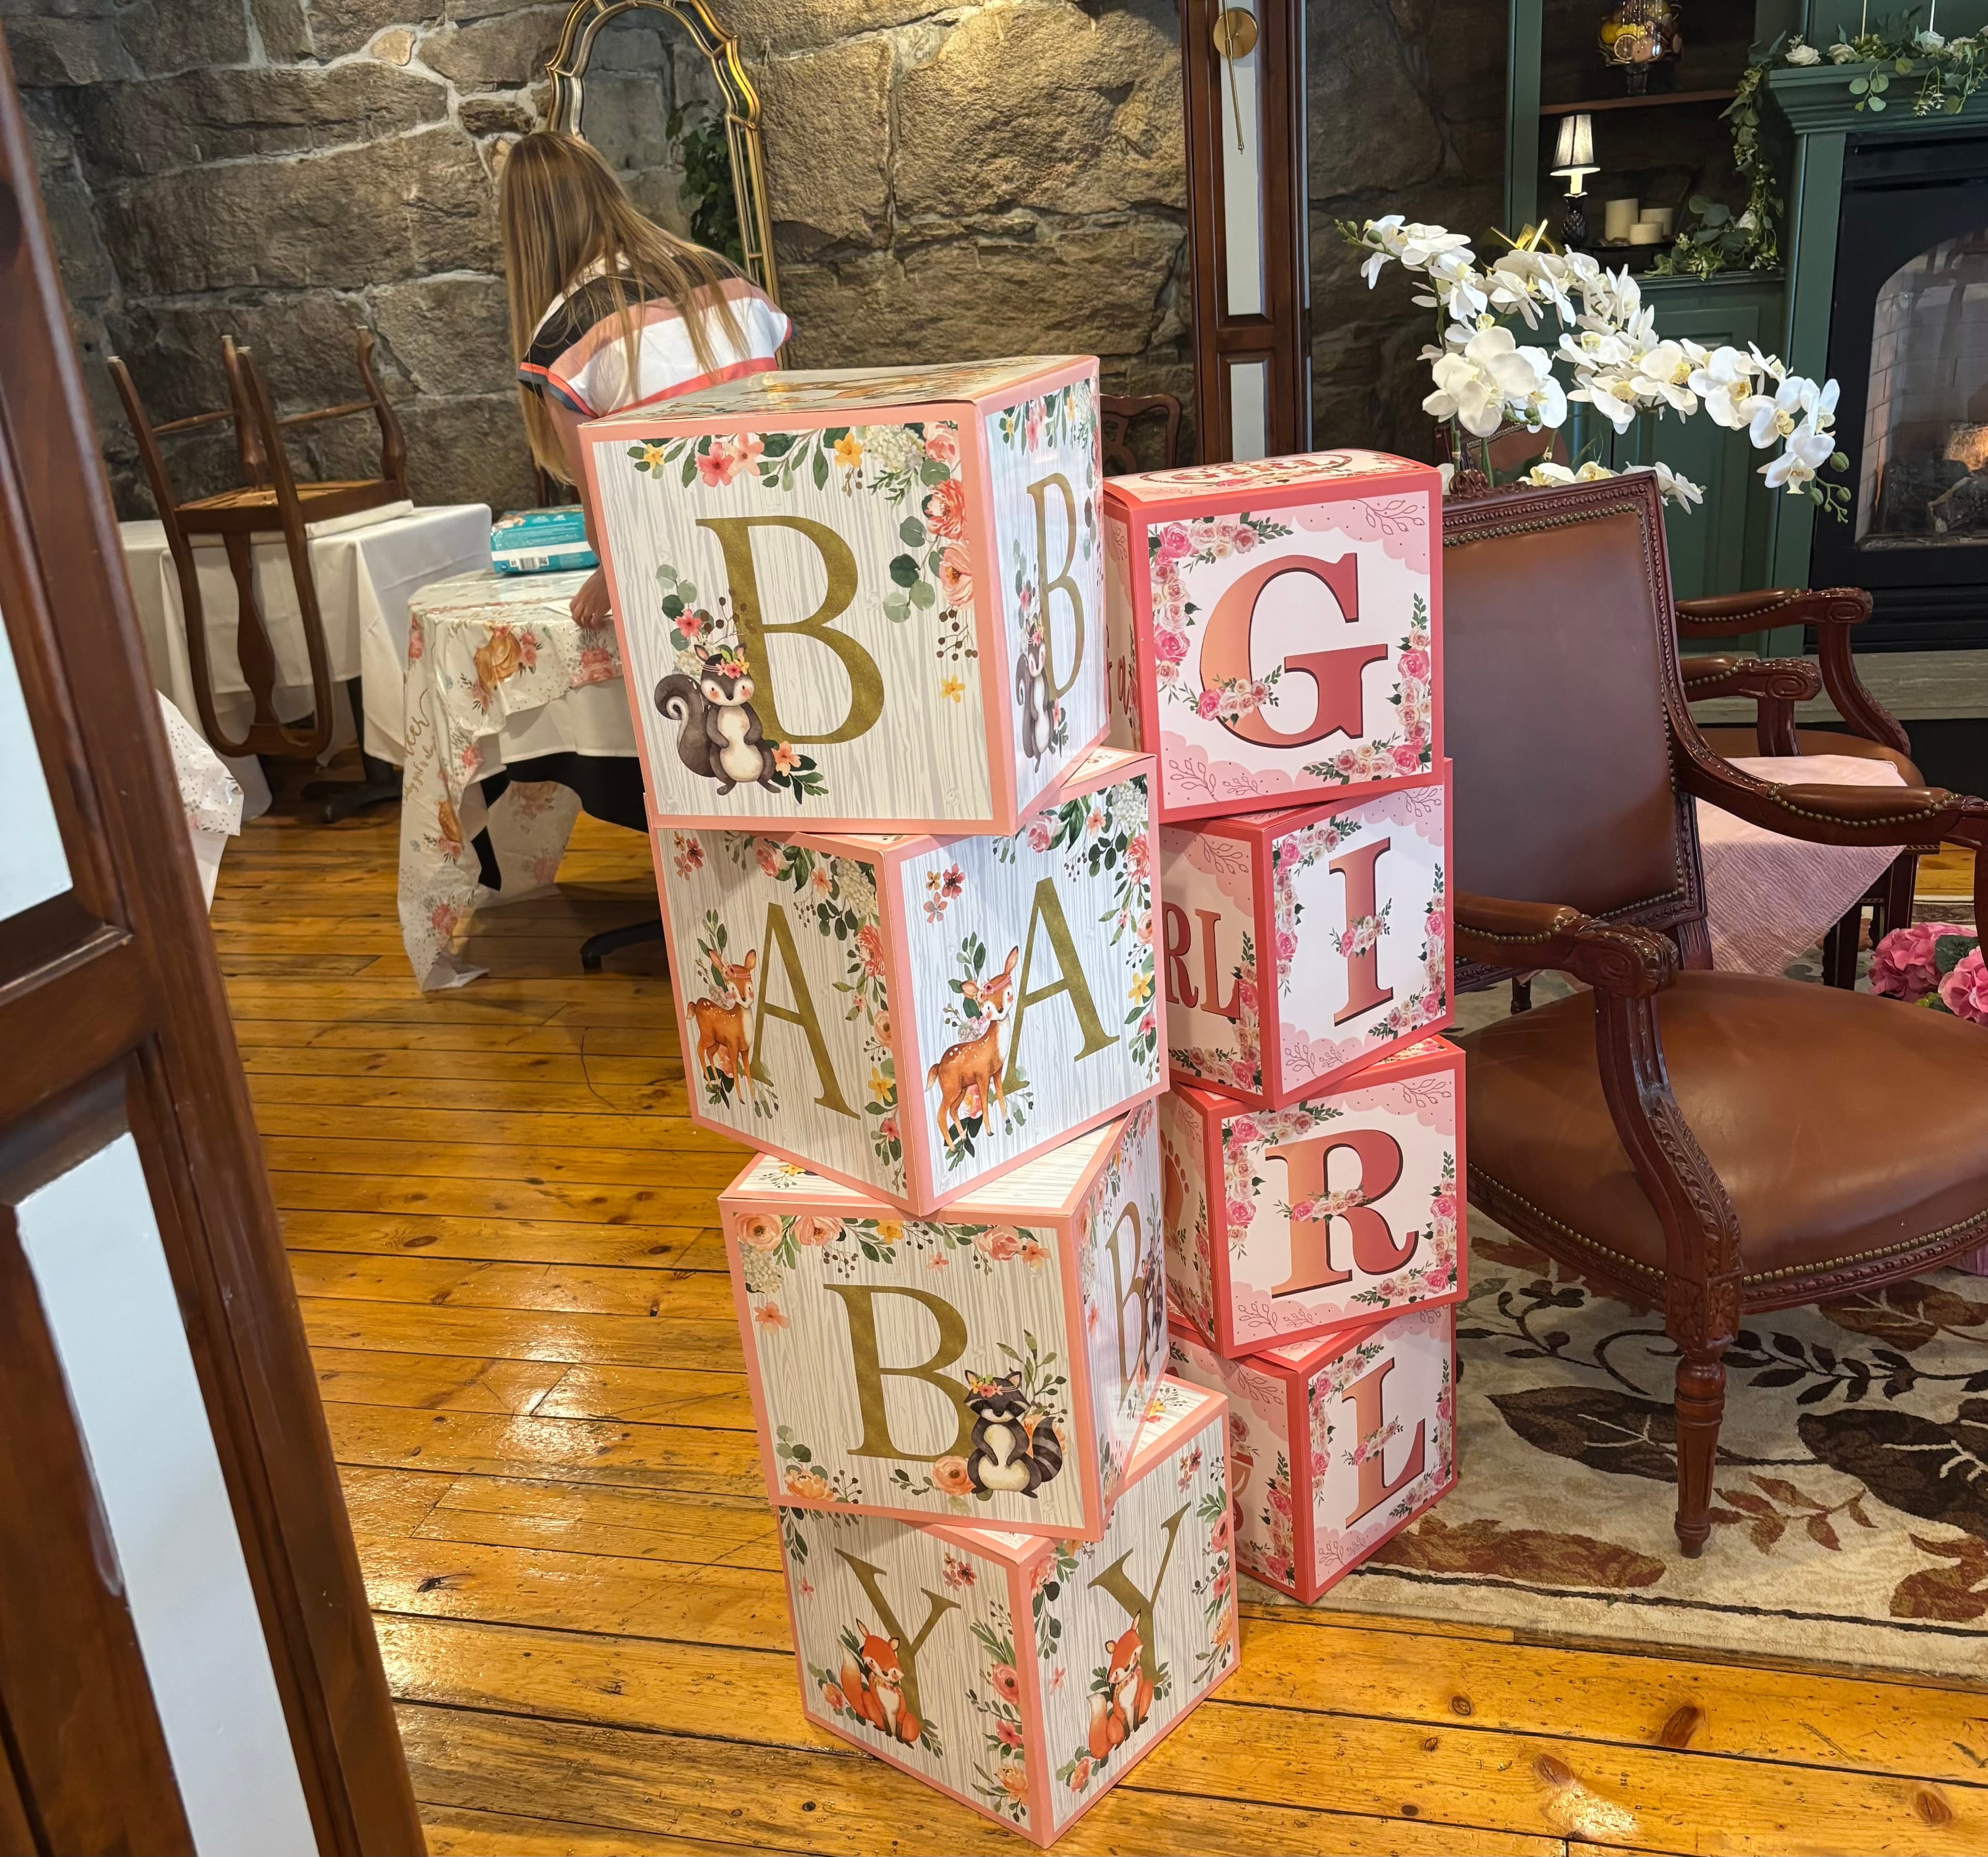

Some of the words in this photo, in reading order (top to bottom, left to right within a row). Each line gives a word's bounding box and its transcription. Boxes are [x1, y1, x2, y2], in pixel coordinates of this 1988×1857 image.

[695, 515, 885, 745] B
[1026, 473, 1085, 699] B
[1200, 553, 1388, 749] G
[750, 902, 860, 1120] A
[988, 876, 1120, 1106] A
[1162, 901, 1240, 1020] RL
[1329, 836, 1394, 1027] I
[1105, 1201, 1146, 1417] B
[1265, 1129, 1419, 1299] R
[823, 1283, 980, 1462] B
[1341, 1357, 1426, 1530] L
[835, 1547, 961, 1728] Y
[1088, 1501, 1191, 1692] Y
